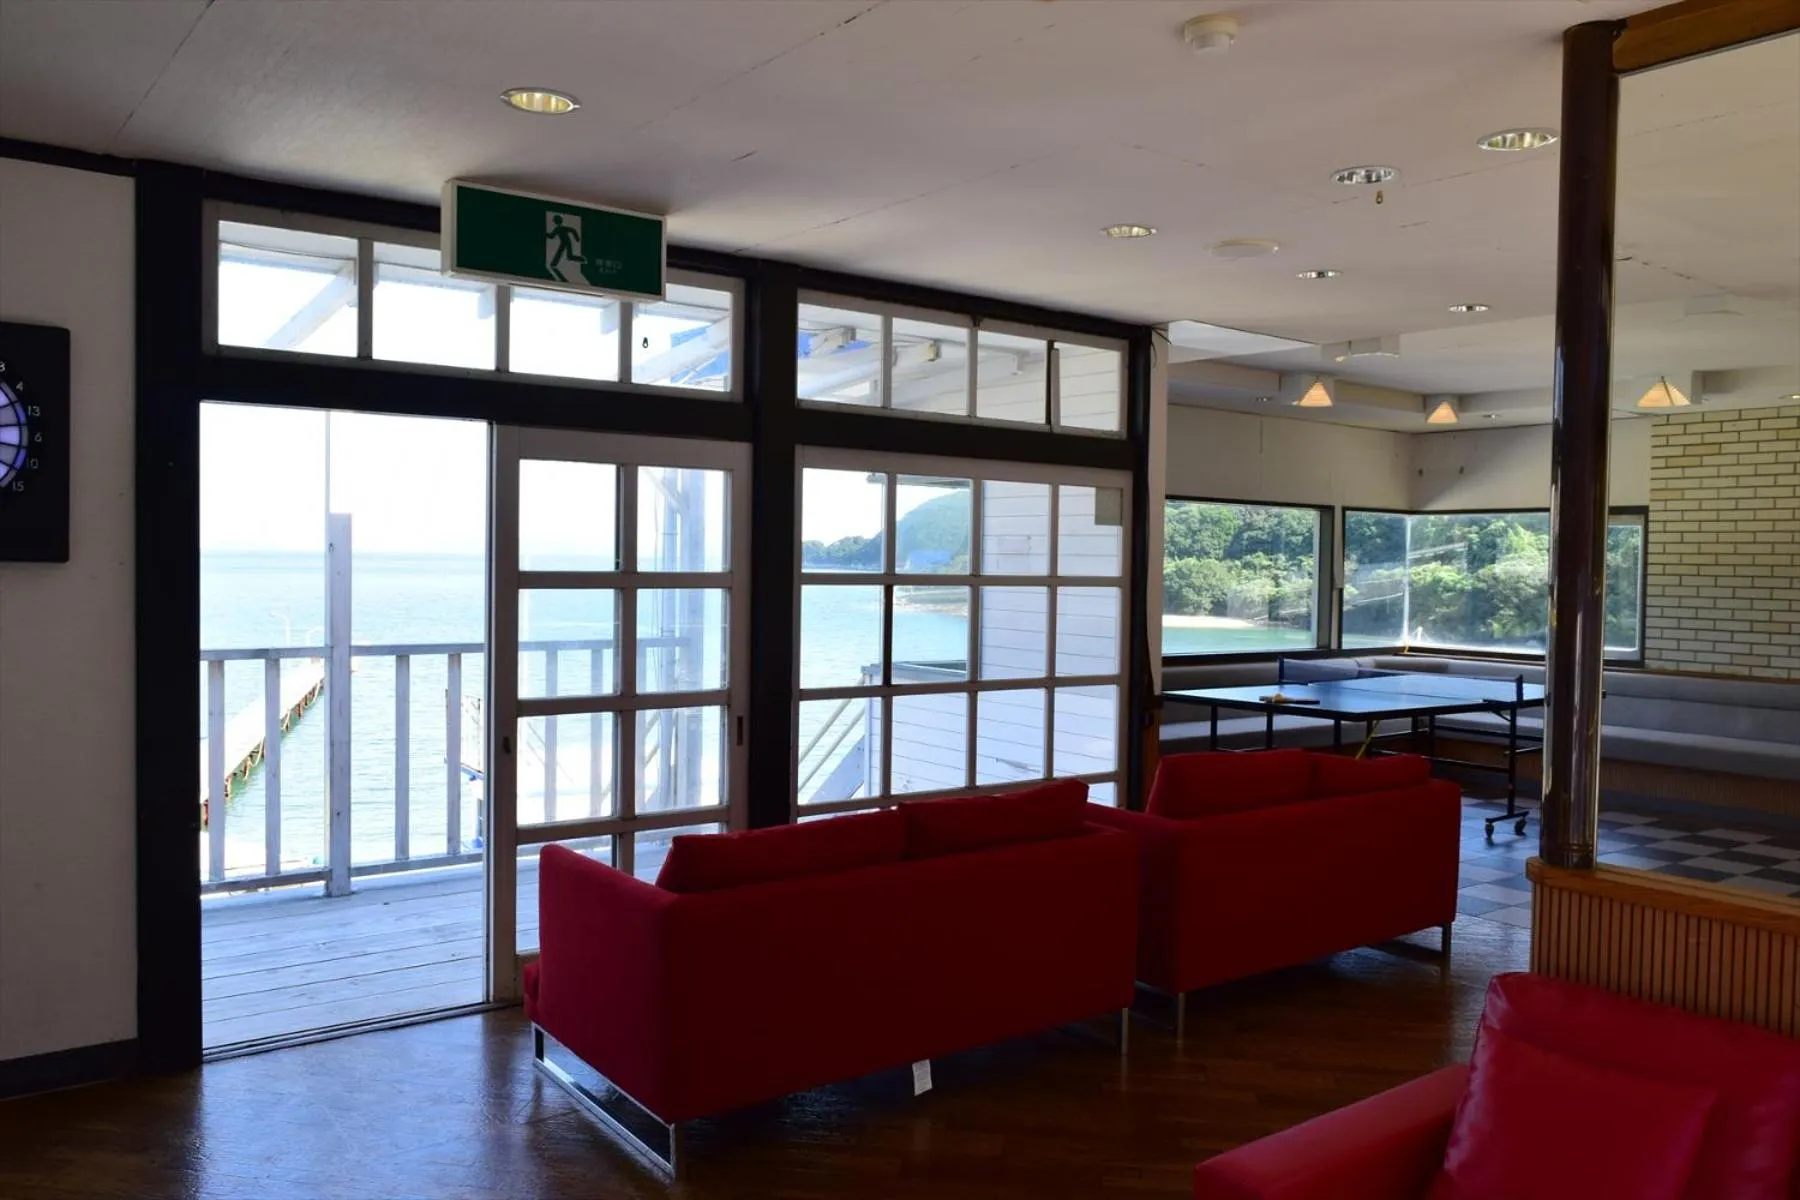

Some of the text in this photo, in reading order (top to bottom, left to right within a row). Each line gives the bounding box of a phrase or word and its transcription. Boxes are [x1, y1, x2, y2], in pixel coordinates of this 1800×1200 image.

[16, 381, 24, 391] 4
[28, 405, 40, 416] 13
[34, 432, 42, 442] 6
[26, 458, 39, 469] 10
[12, 481, 24, 492] 15
